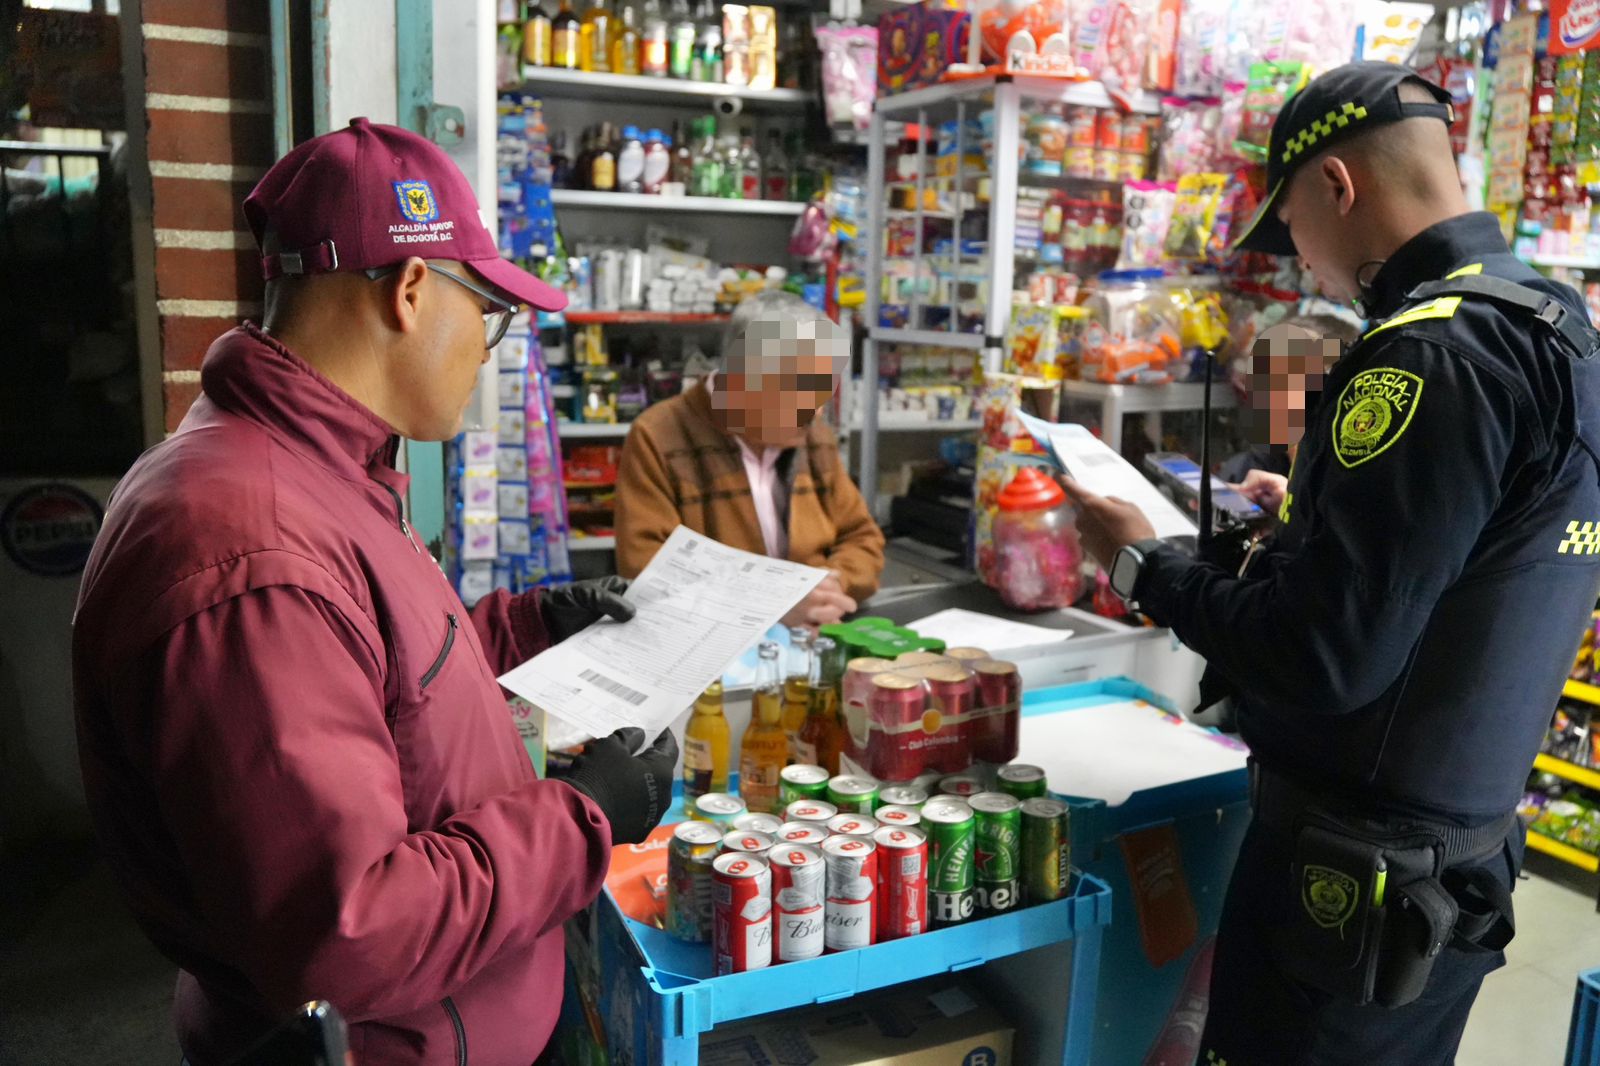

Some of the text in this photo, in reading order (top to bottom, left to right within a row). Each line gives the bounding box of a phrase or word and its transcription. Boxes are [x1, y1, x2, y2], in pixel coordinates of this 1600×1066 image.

[429, 221, 454, 232] MAYOR
[393, 235, 407, 243] DE
[407, 231, 439, 243] BOGOTÁ
[1354, 373, 1411, 397] POLICÍA
[1343, 385, 1408, 412] NACIONAL
